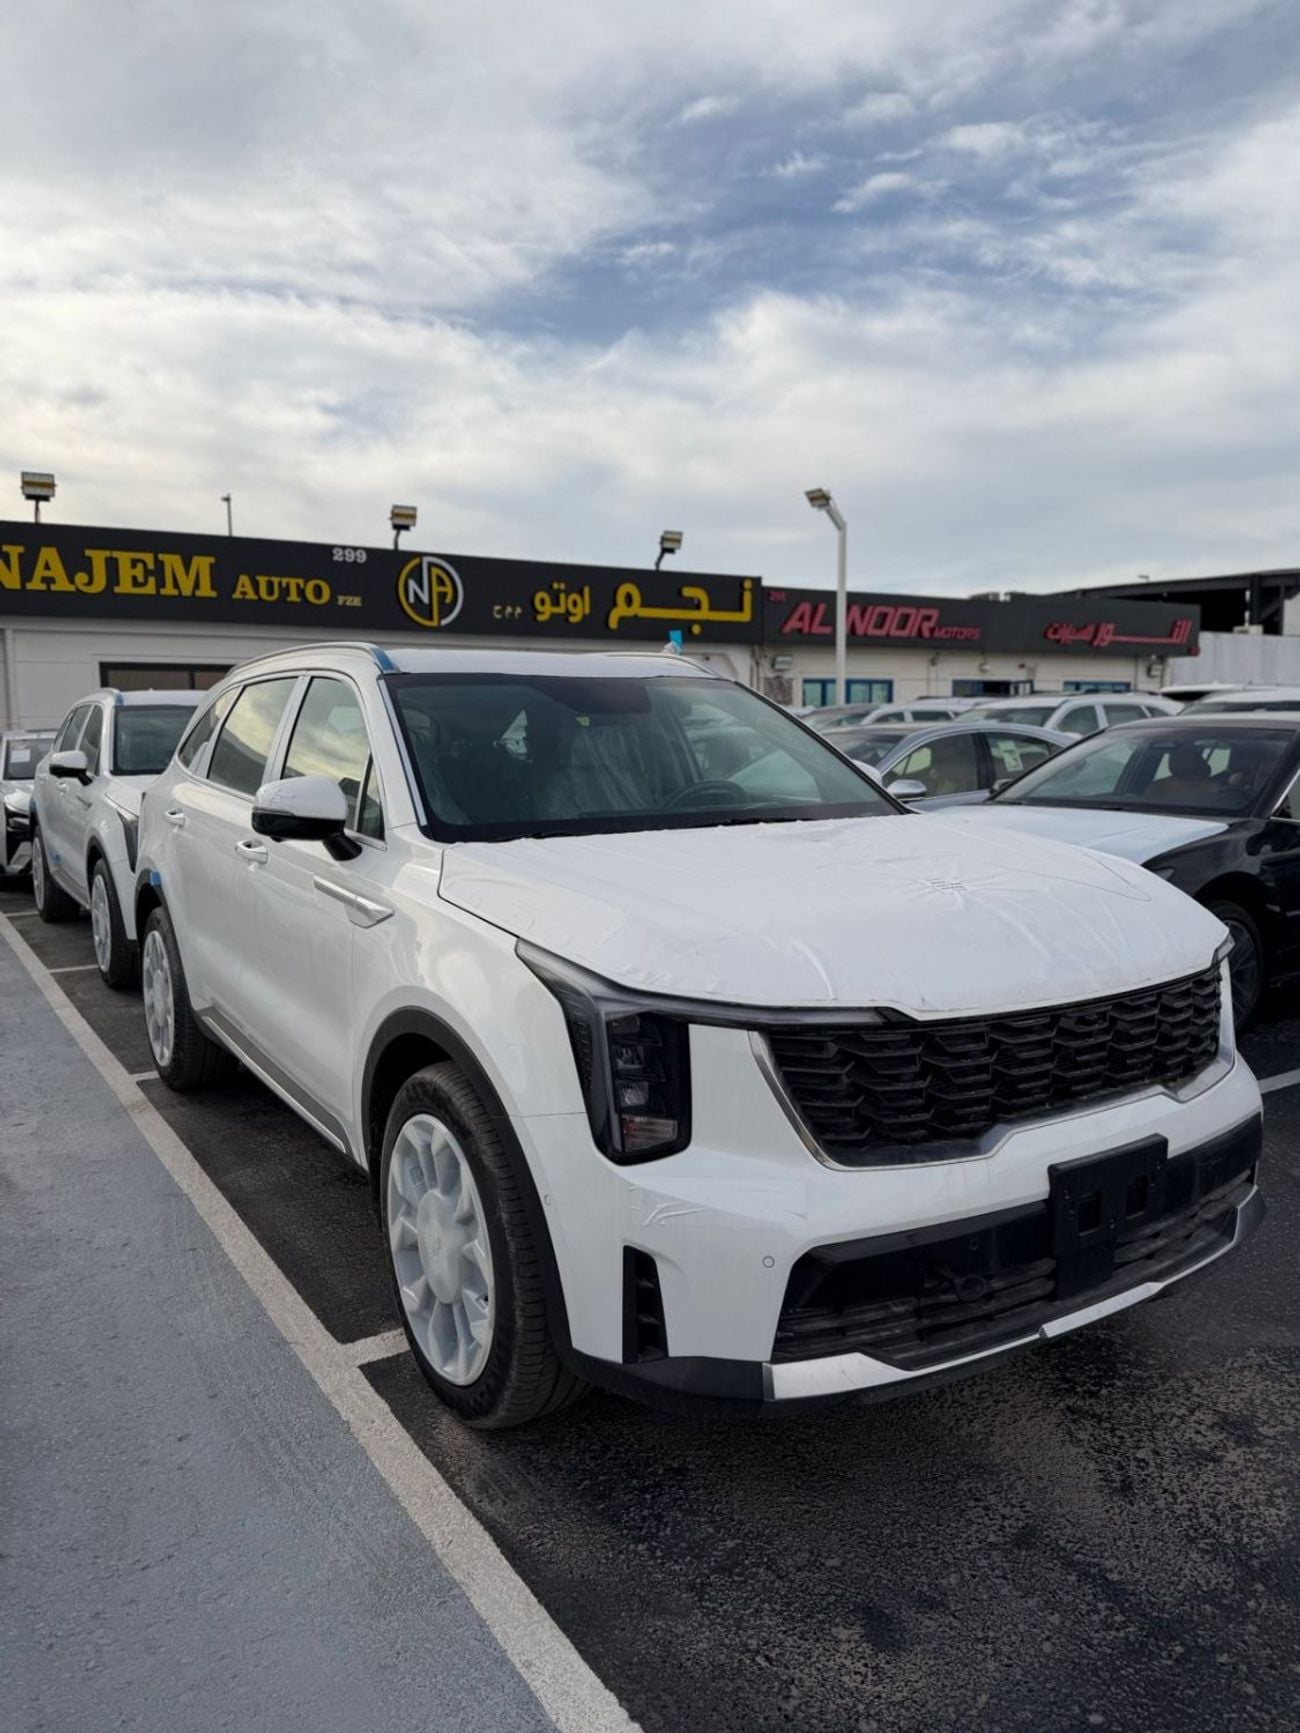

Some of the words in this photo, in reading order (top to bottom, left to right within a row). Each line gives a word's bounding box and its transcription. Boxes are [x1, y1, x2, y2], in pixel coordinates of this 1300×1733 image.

[332, 547, 367, 563] 299
[231, 574, 332, 605] AUTO
[534, 581, 591, 623] اوتو
[608, 579, 753, 635] نجم
[782, 601, 833, 635] AL
[846, 603, 939, 638] NOOR
[933, 627, 982, 639] MOTORS
